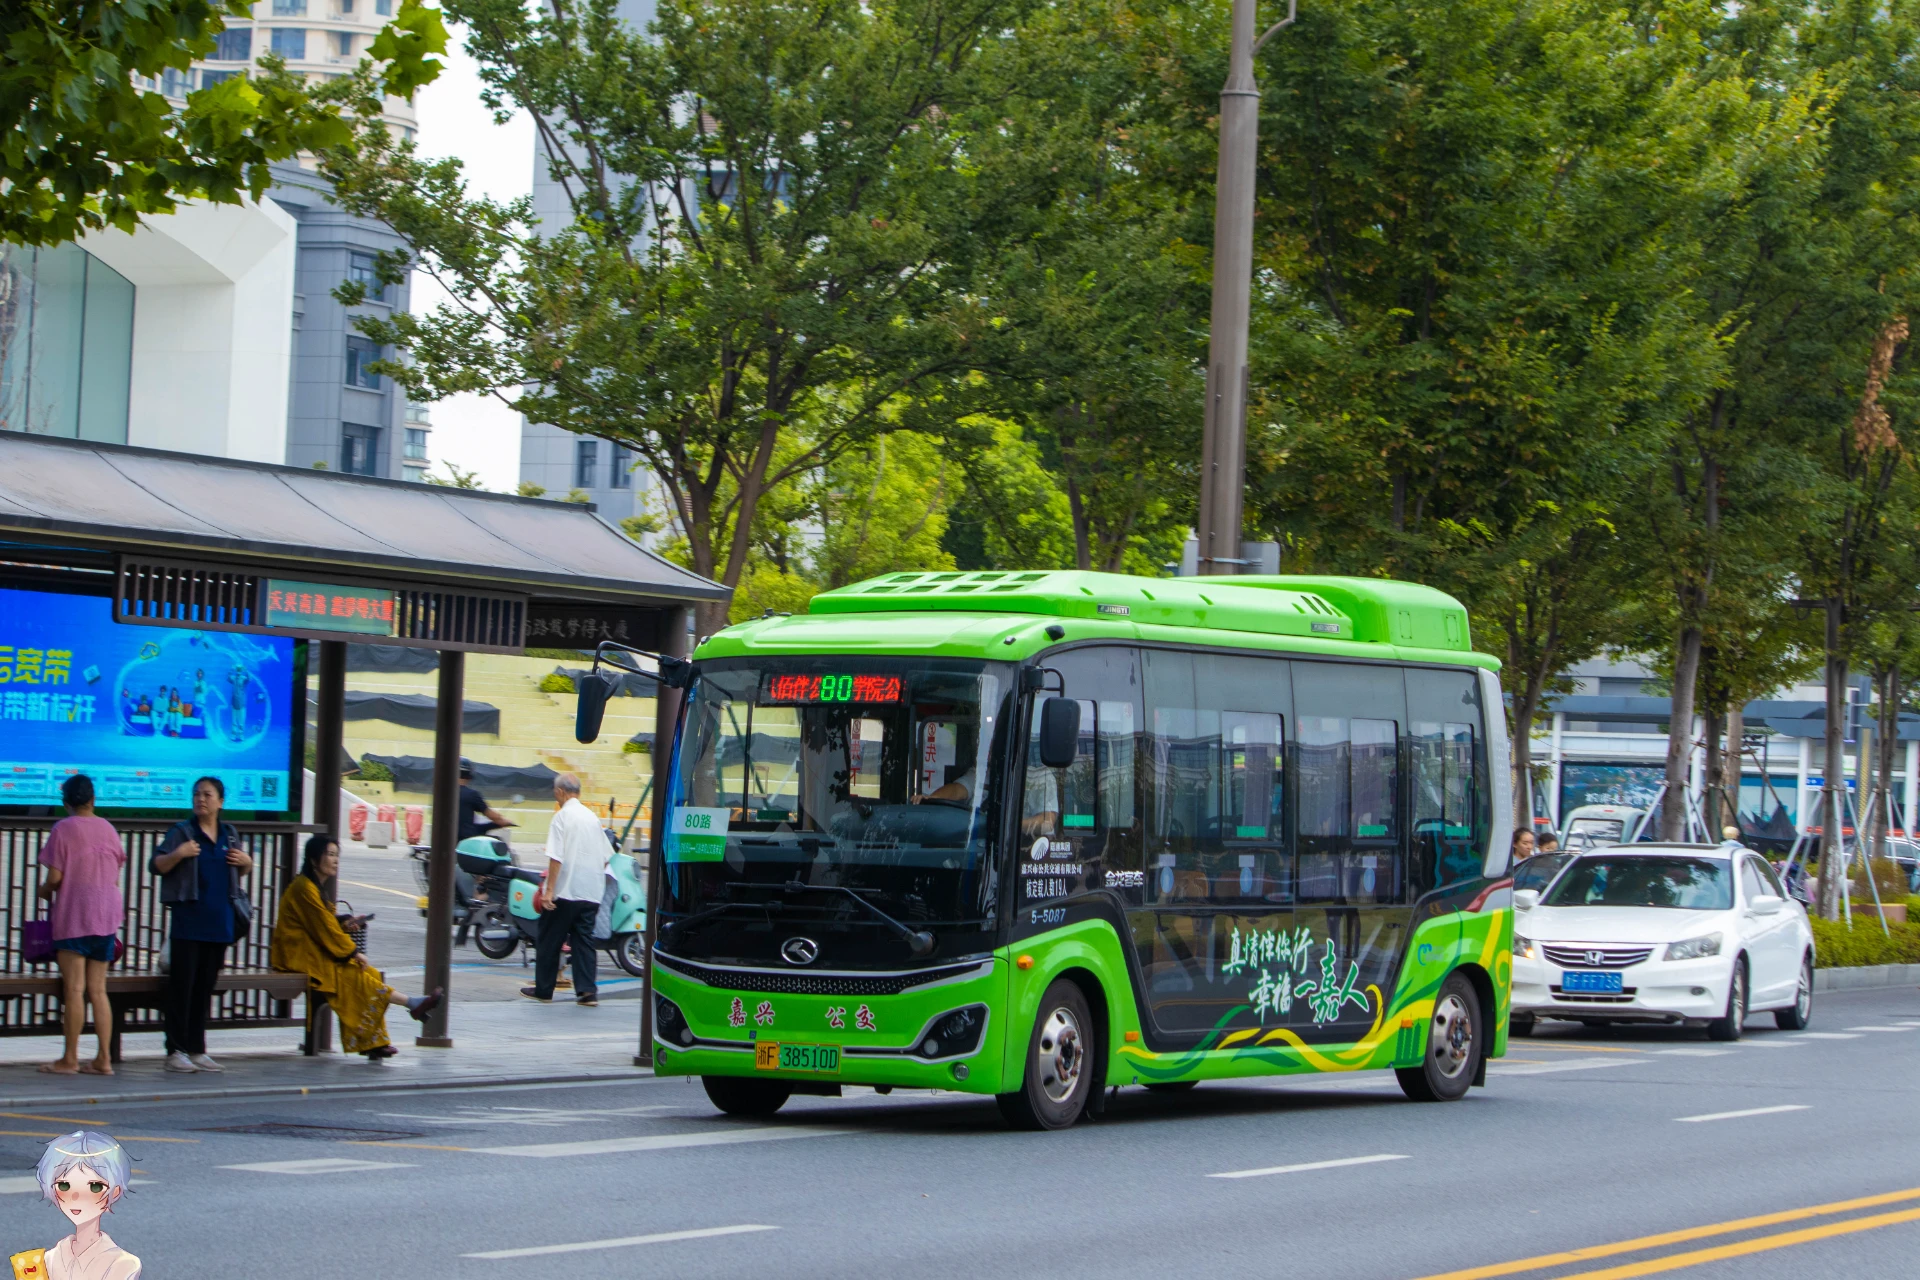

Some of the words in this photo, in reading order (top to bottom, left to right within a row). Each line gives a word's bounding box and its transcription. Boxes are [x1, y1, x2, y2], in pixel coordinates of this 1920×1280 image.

[820, 675, 853, 701] 80
[853, 676, 906, 702] 学院公
[0, 691, 97, 723] 带新标杆
[685, 813, 711, 829] 80路
[1021, 864, 1082, 875] 嘉兴市公共交通有限公司
[1105, 871, 1144, 888] 金龙客车
[1026, 878, 1068, 898] 核定载人数19人
[1031, 909, 1067, 924] 5-5087
[1221, 925, 1314, 975] 真情伴你行
[728, 997, 775, 1027] 嘉兴
[825, 1004, 876, 1031] 公交
